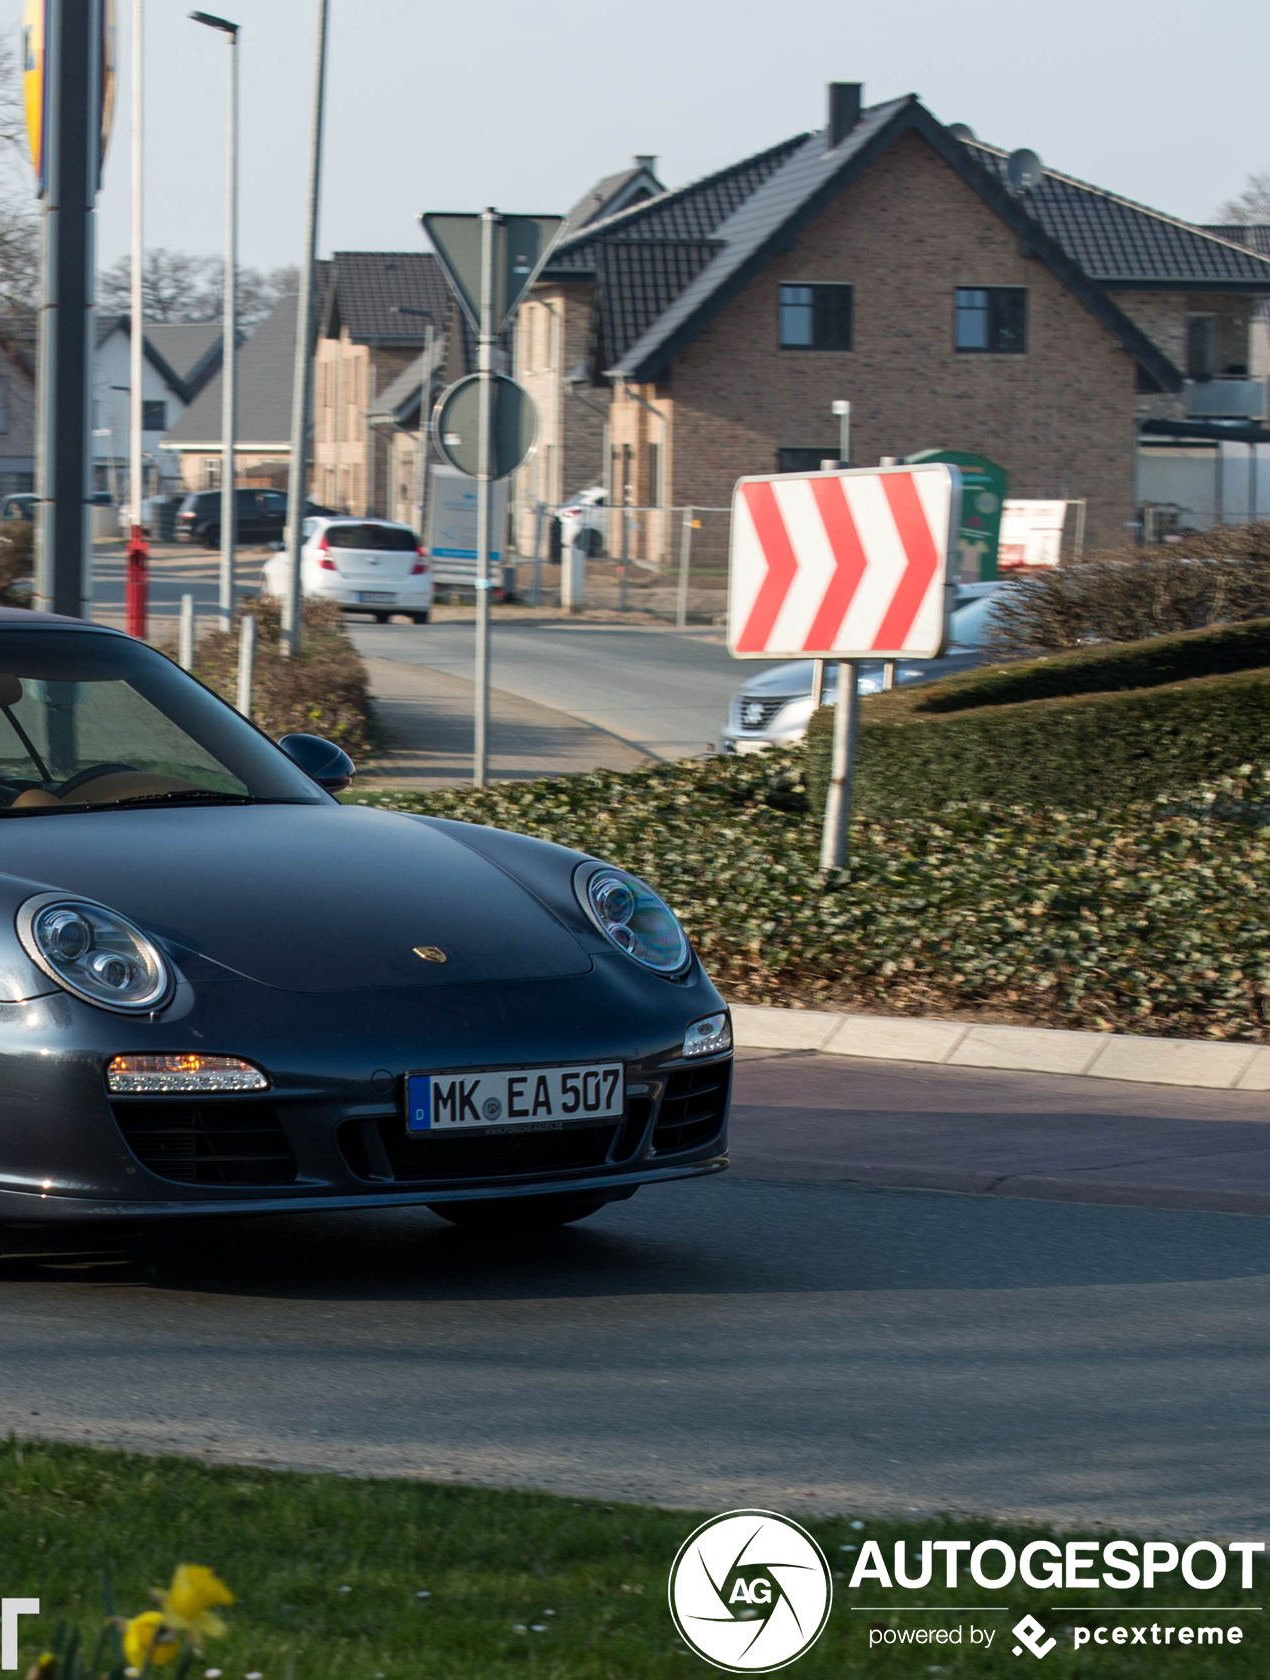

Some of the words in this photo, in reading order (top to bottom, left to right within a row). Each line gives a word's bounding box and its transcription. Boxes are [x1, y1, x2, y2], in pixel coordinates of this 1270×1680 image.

[433, 1079, 481, 1122] MK
[507, 1075, 552, 1117] EA
[561, 1069, 620, 1113] 507
[416, 1109, 424, 1120] D
